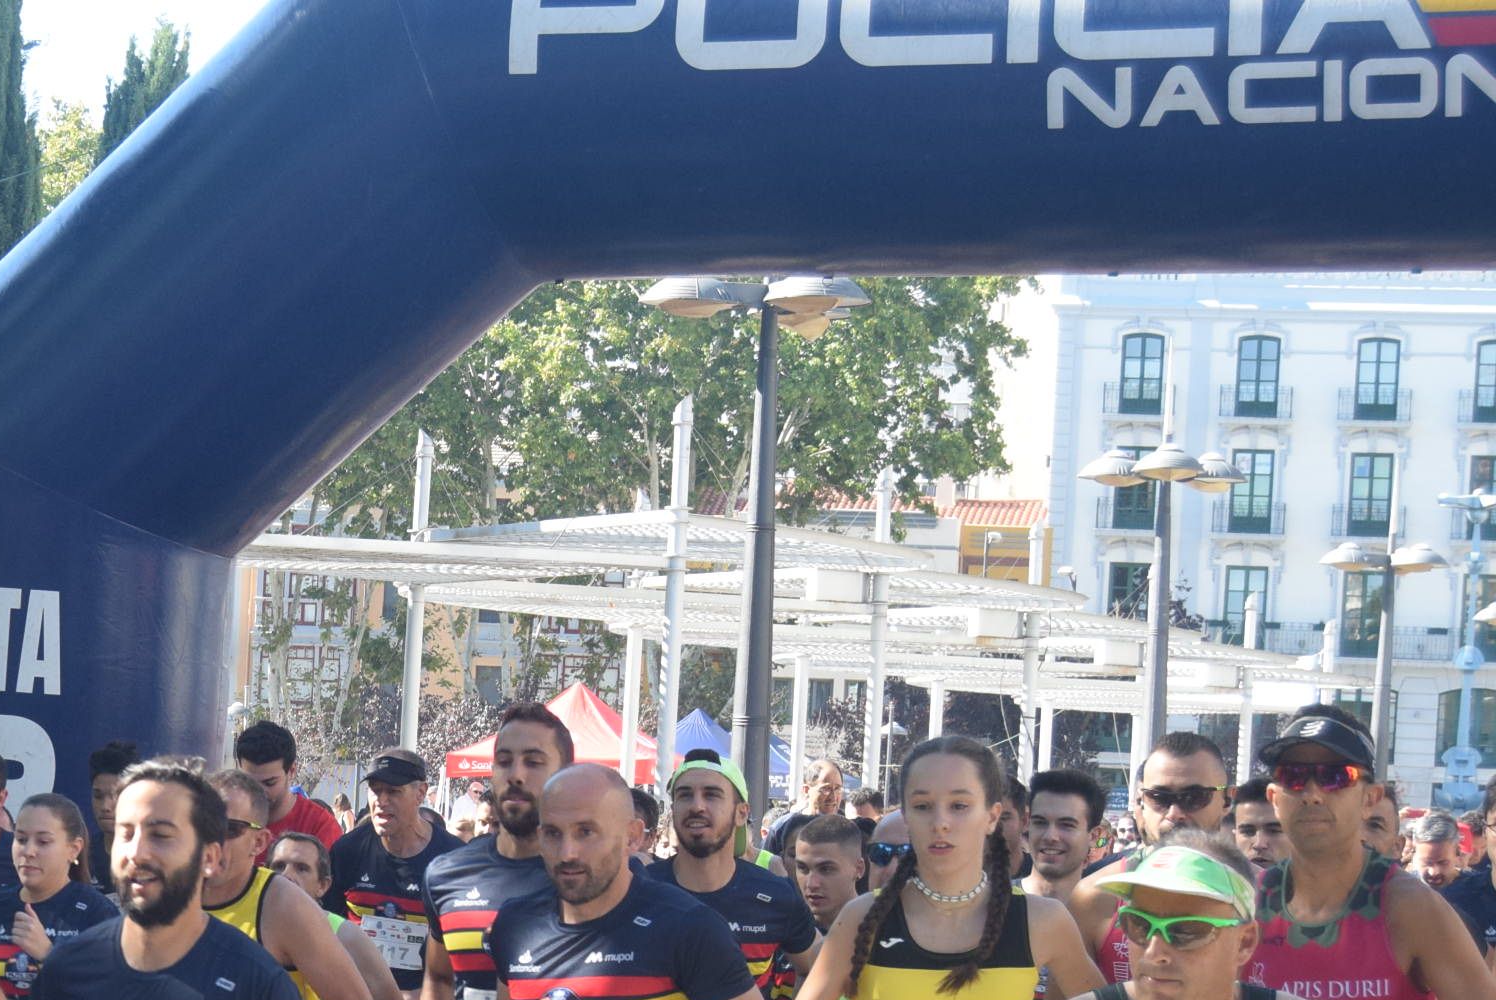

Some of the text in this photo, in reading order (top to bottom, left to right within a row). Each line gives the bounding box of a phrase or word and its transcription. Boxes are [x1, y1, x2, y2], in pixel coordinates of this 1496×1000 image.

[743, 924, 767, 934] mupol
[605, 951, 634, 964] mupol
[1327, 978, 1390, 999] DURII
